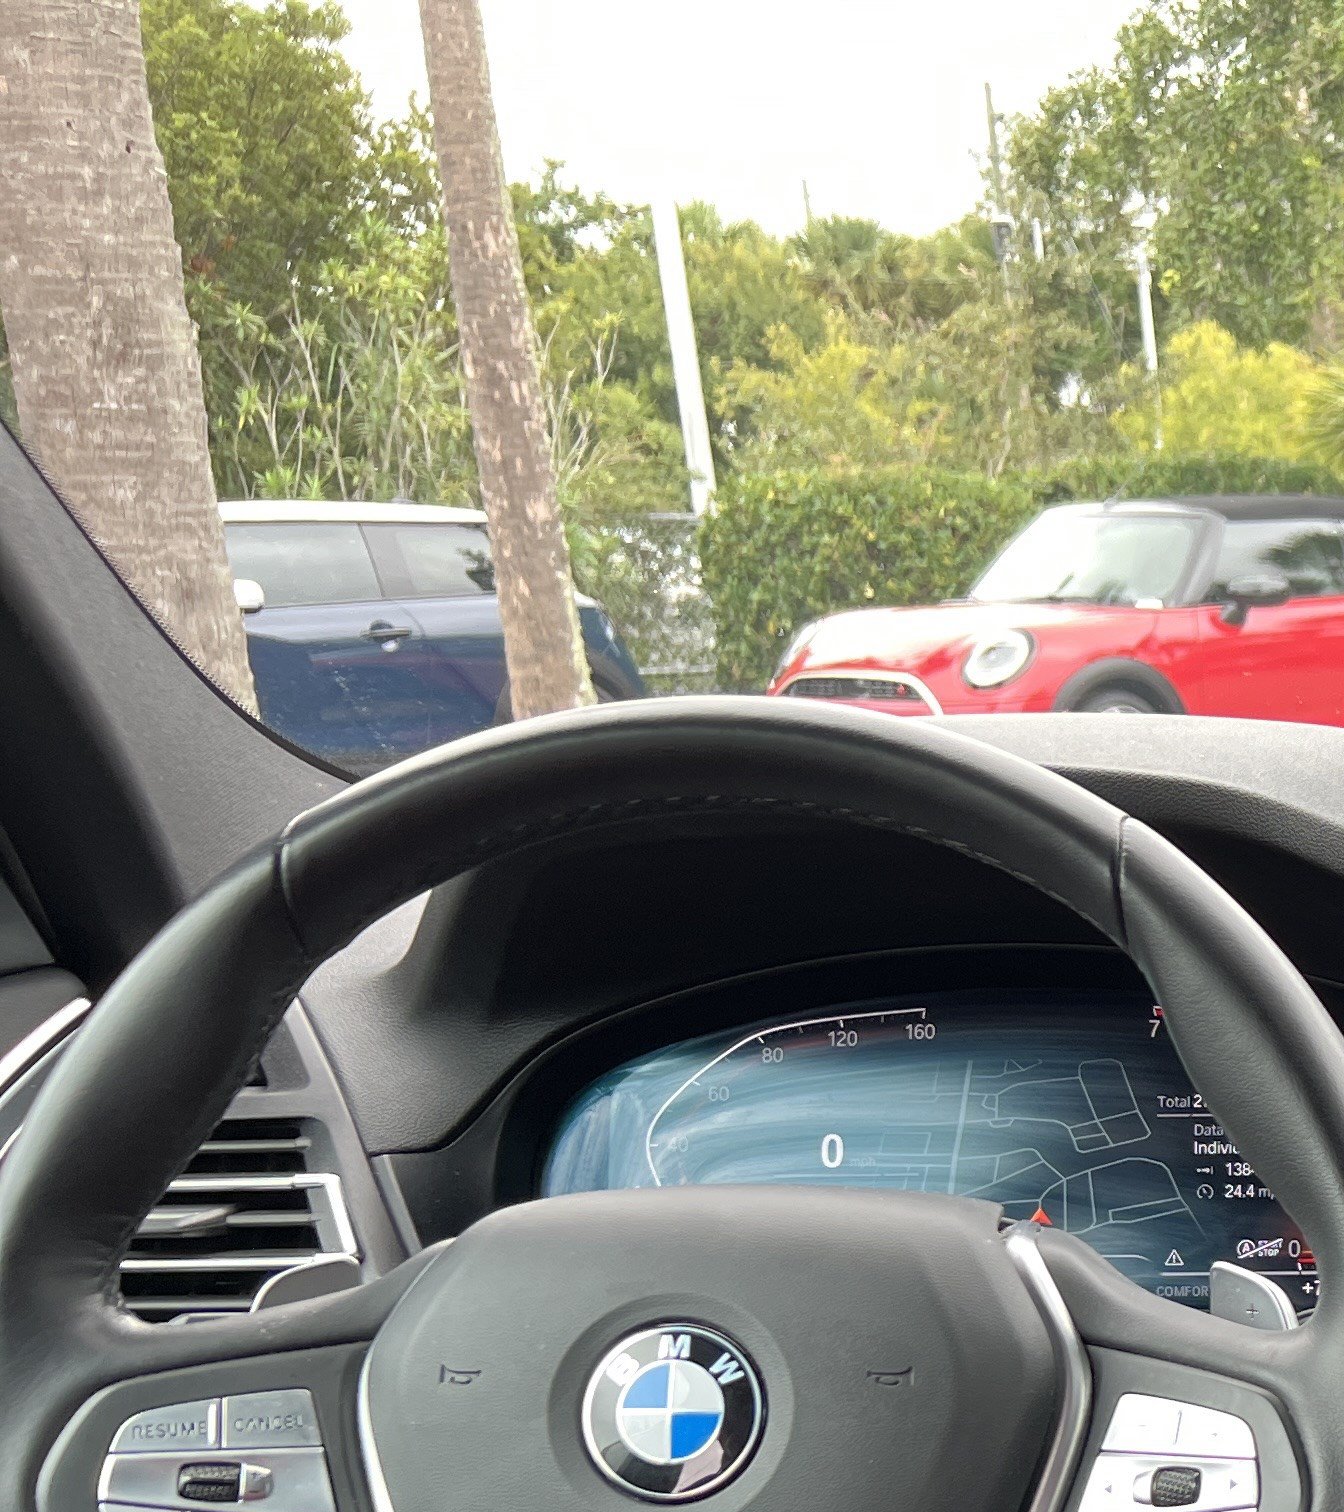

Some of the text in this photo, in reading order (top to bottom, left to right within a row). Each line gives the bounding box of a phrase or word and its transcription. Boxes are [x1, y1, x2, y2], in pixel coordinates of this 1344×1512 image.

[904, 1023, 936, 1040] 160
[1149, 1020, 1160, 1038] 7
[827, 1030, 858, 1047] 120
[761, 1047, 784, 1063] 80
[708, 1086, 730, 1102] 60
[1157, 1095, 1191, 1108] Total
[1194, 1123, 1224, 1136] Data
[821, 1133, 844, 1168] 0
[1225, 1162, 1255, 1177] 138
[1224, 1184, 1255, 1199] 24.4
[1156, 1285, 1209, 1298] COMFOR
[606, 1333, 745, 1387] BMW
[132, 1421, 208, 1441] RESUME
[234, 1413, 305, 1433] CANCEL
